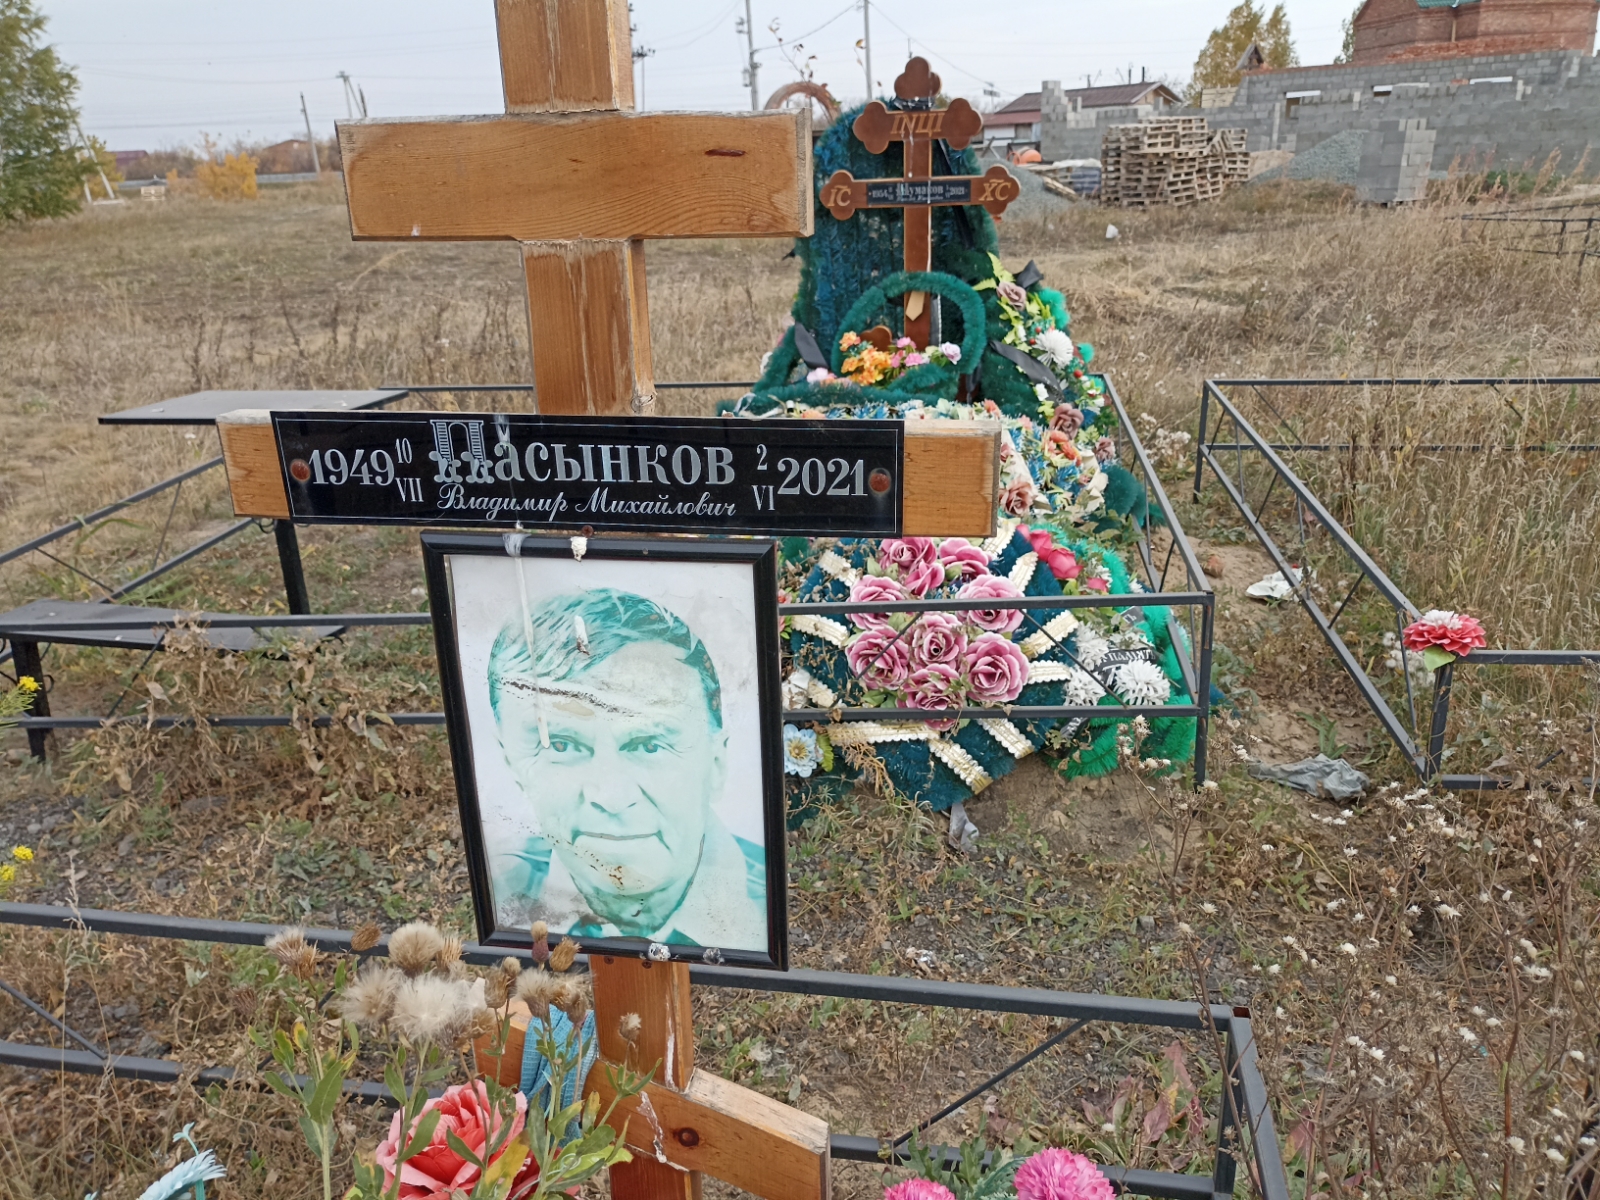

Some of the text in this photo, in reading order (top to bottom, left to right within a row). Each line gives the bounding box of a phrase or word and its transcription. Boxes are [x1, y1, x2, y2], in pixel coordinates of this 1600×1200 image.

[950, 186, 965, 196] 2021
[309, 419, 869, 497] 1949 Пасынков 2021
[395, 438, 413, 464] 10
[756, 443, 769, 471] 2
[395, 475, 424, 503] VII
[437, 483, 736, 520] Владимир Михайлович
[752, 485, 776, 511] VI
